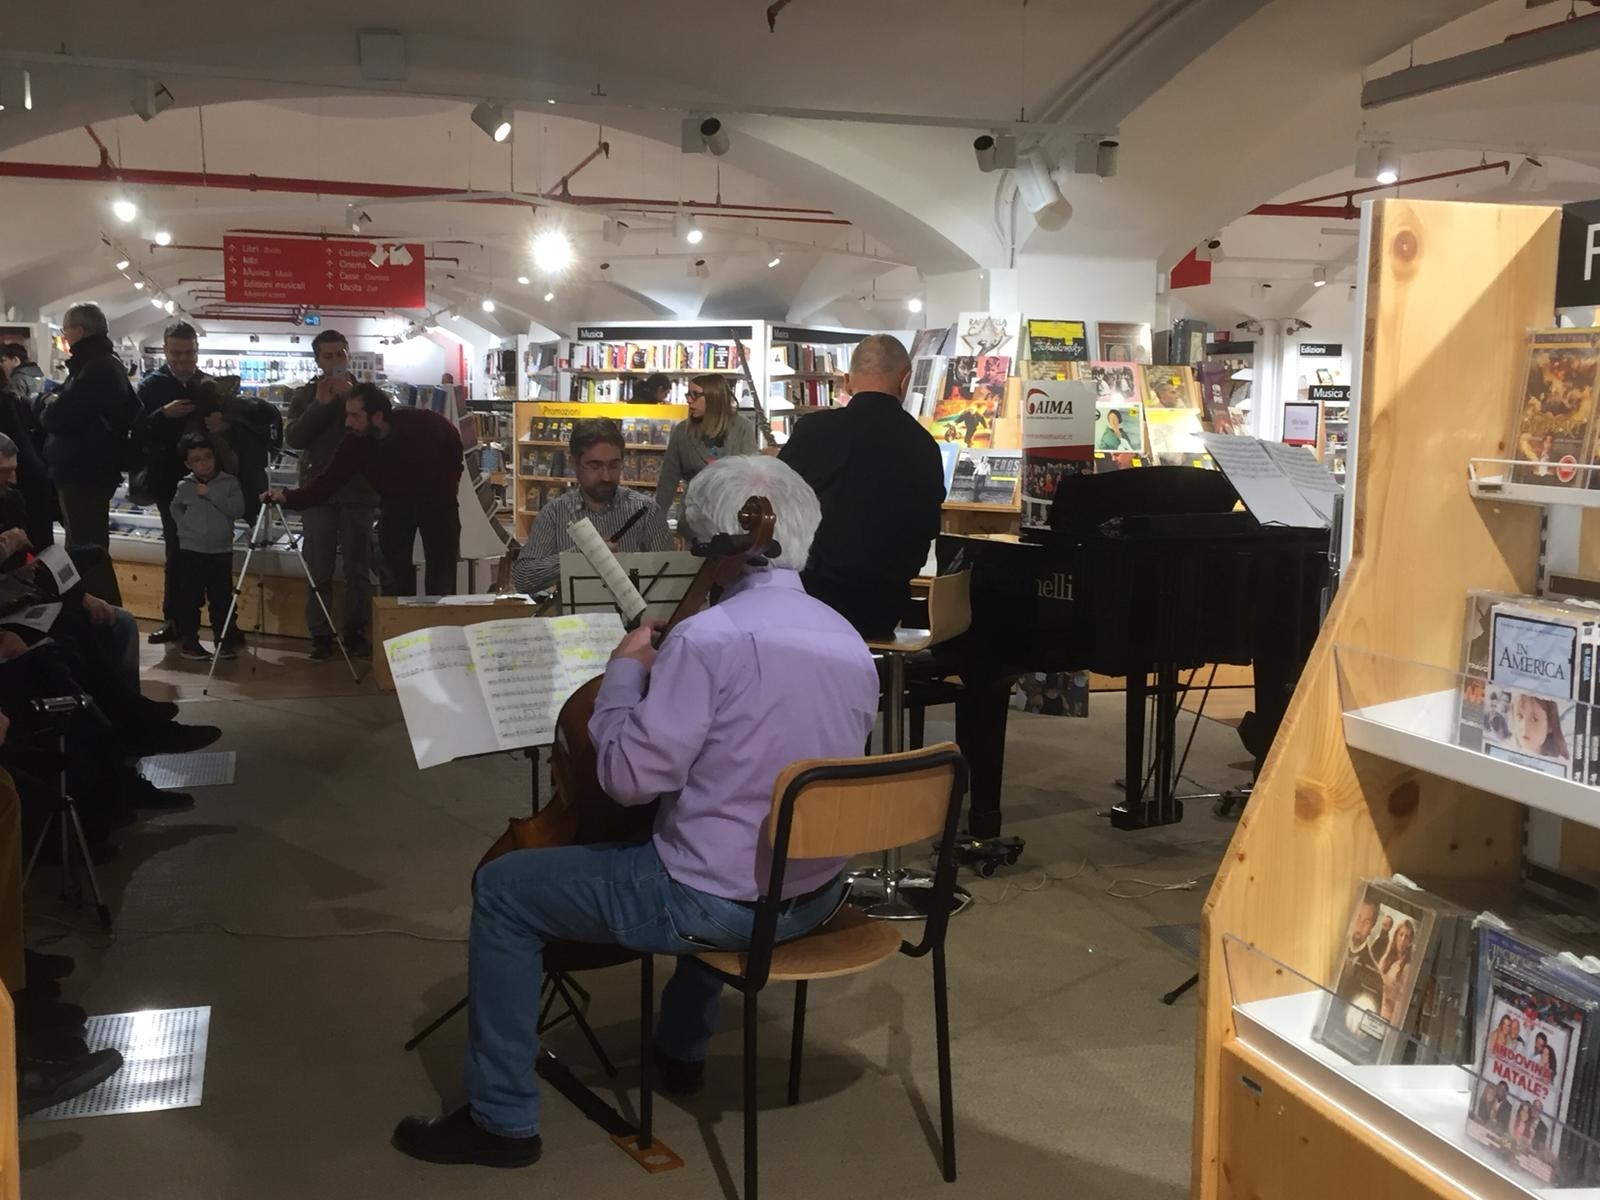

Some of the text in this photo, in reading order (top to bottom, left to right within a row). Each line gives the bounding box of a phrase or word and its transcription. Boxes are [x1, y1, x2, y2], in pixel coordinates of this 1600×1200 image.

[580, 329, 604, 338] Musica
[1300, 345, 1327, 354] Edizioni
[1313, 387, 1343, 398] Musica
[542, 406, 582, 417] Promozioni
[993, 459, 1021, 472] EROS
[1517, 643, 1529, 655] IN
[1499, 647, 1565, 681] AMERICA
[1492, 1060, 1550, 1100] NATALE?
